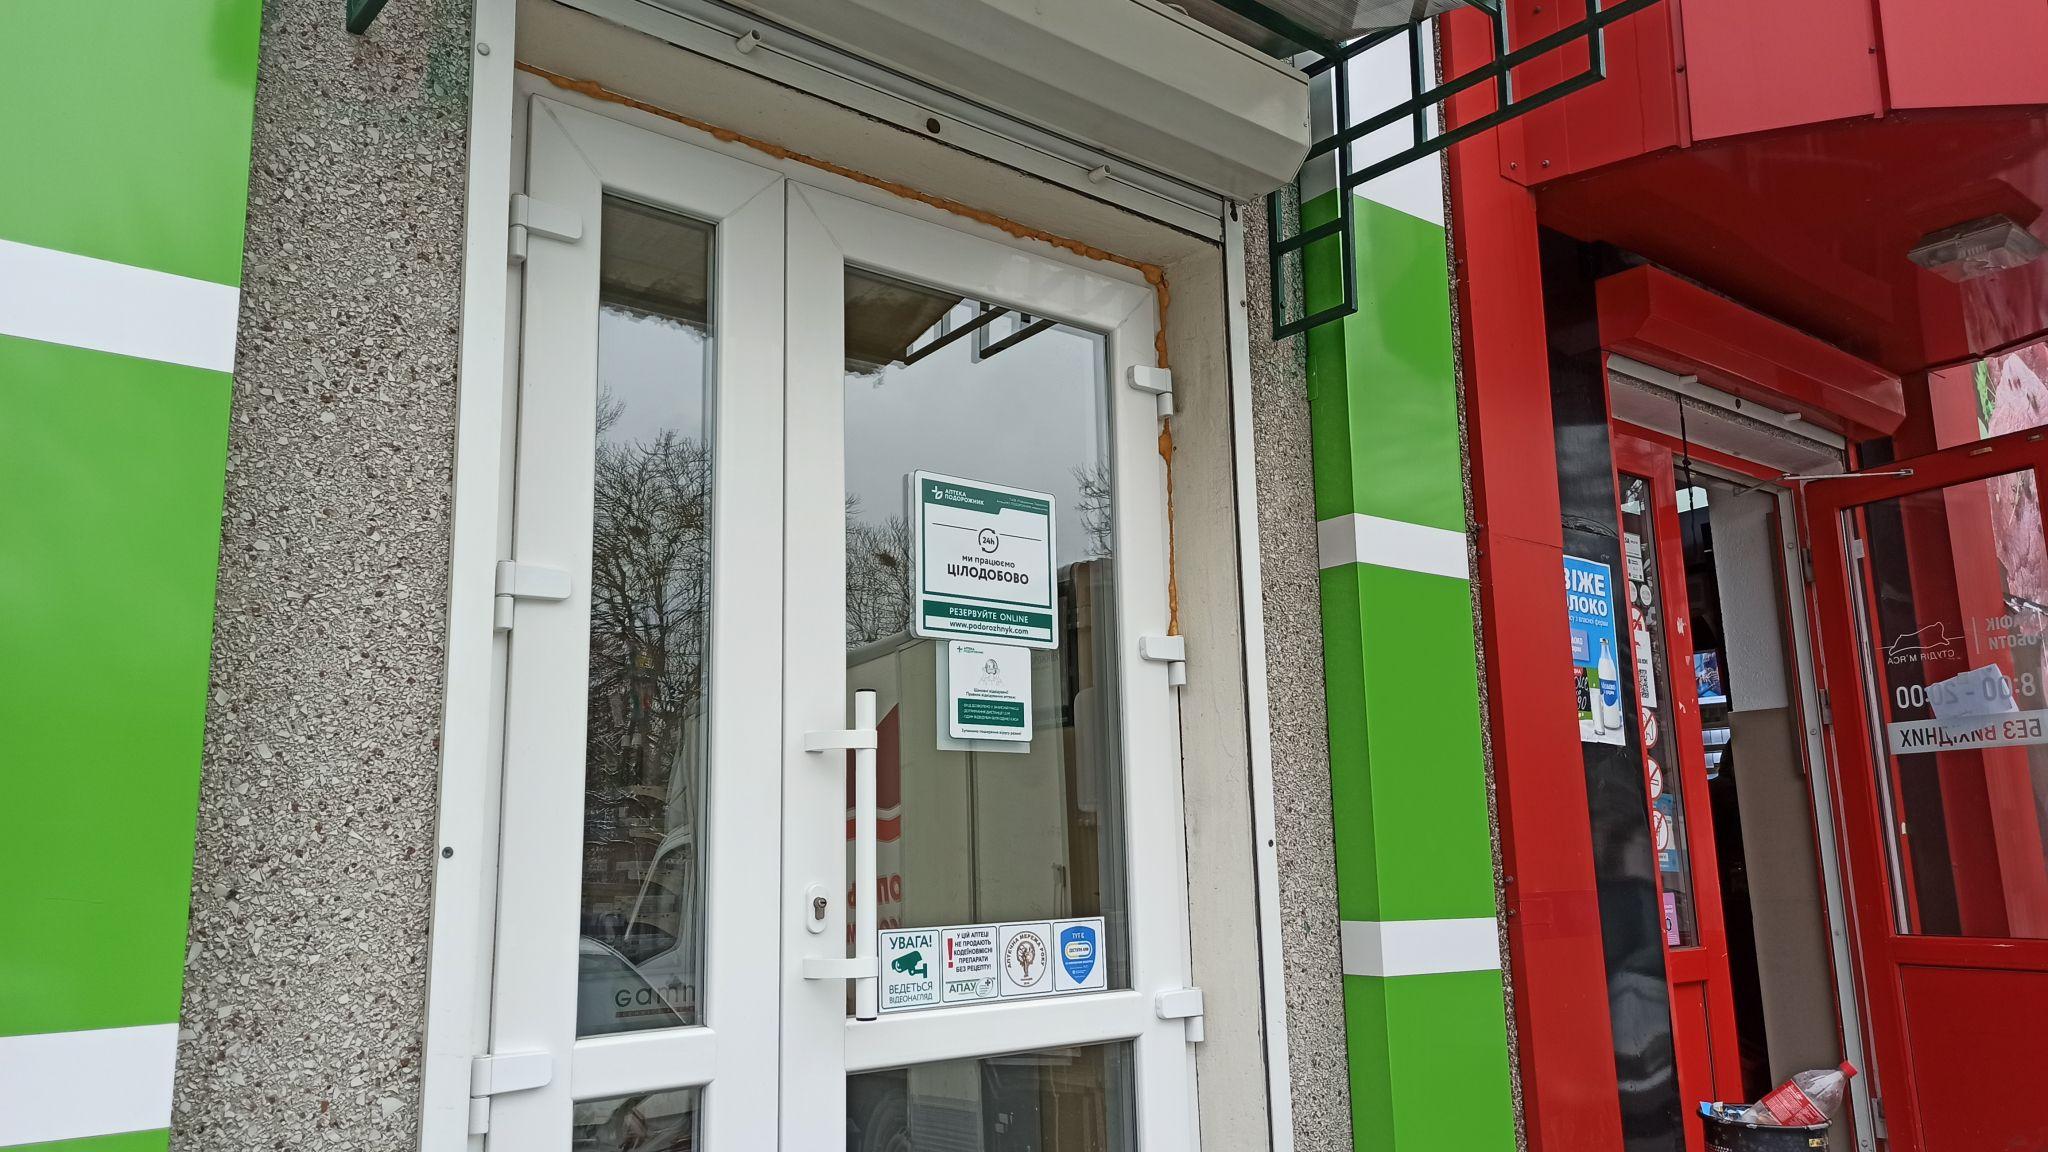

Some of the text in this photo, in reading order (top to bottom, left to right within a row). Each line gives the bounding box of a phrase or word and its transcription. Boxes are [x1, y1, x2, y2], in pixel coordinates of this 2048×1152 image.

[944, 489, 966, 498] АПТЕКА
[944, 494, 984, 506] ПОДОРОЖНИК
[982, 536, 995, 545] 24h
[974, 556, 1016, 569] працюємо
[947, 563, 1029, 585] ЦІЛОДОБОВО
[1564, 567, 1606, 597] ВІЖЕ
[1567, 594, 1608, 617] ЛОКО
[949, 606, 1029, 624] РЕЗЕРВУЙТЕ ONLINE
[949, 620, 1029, 635] www.podorozhnyk.com
[961, 931, 970, 939] ЦІЙ
[889, 934, 932, 950] УВАГА!
[1008, 937, 1019, 968] АПТЕЧНА
[1019, 933, 1041, 947] МЕРЕЖА
[958, 956, 989, 964] ПРЕПАРАТИ
[956, 964, 991, 973] БЕЗ РЕЦЕПТУ!
[888, 981, 933, 995] ВЕДЕТЬСЯ
[949, 982, 976, 993] АПАУ
[889, 995, 933, 1004] ВІДЕОНАГЛЯД
